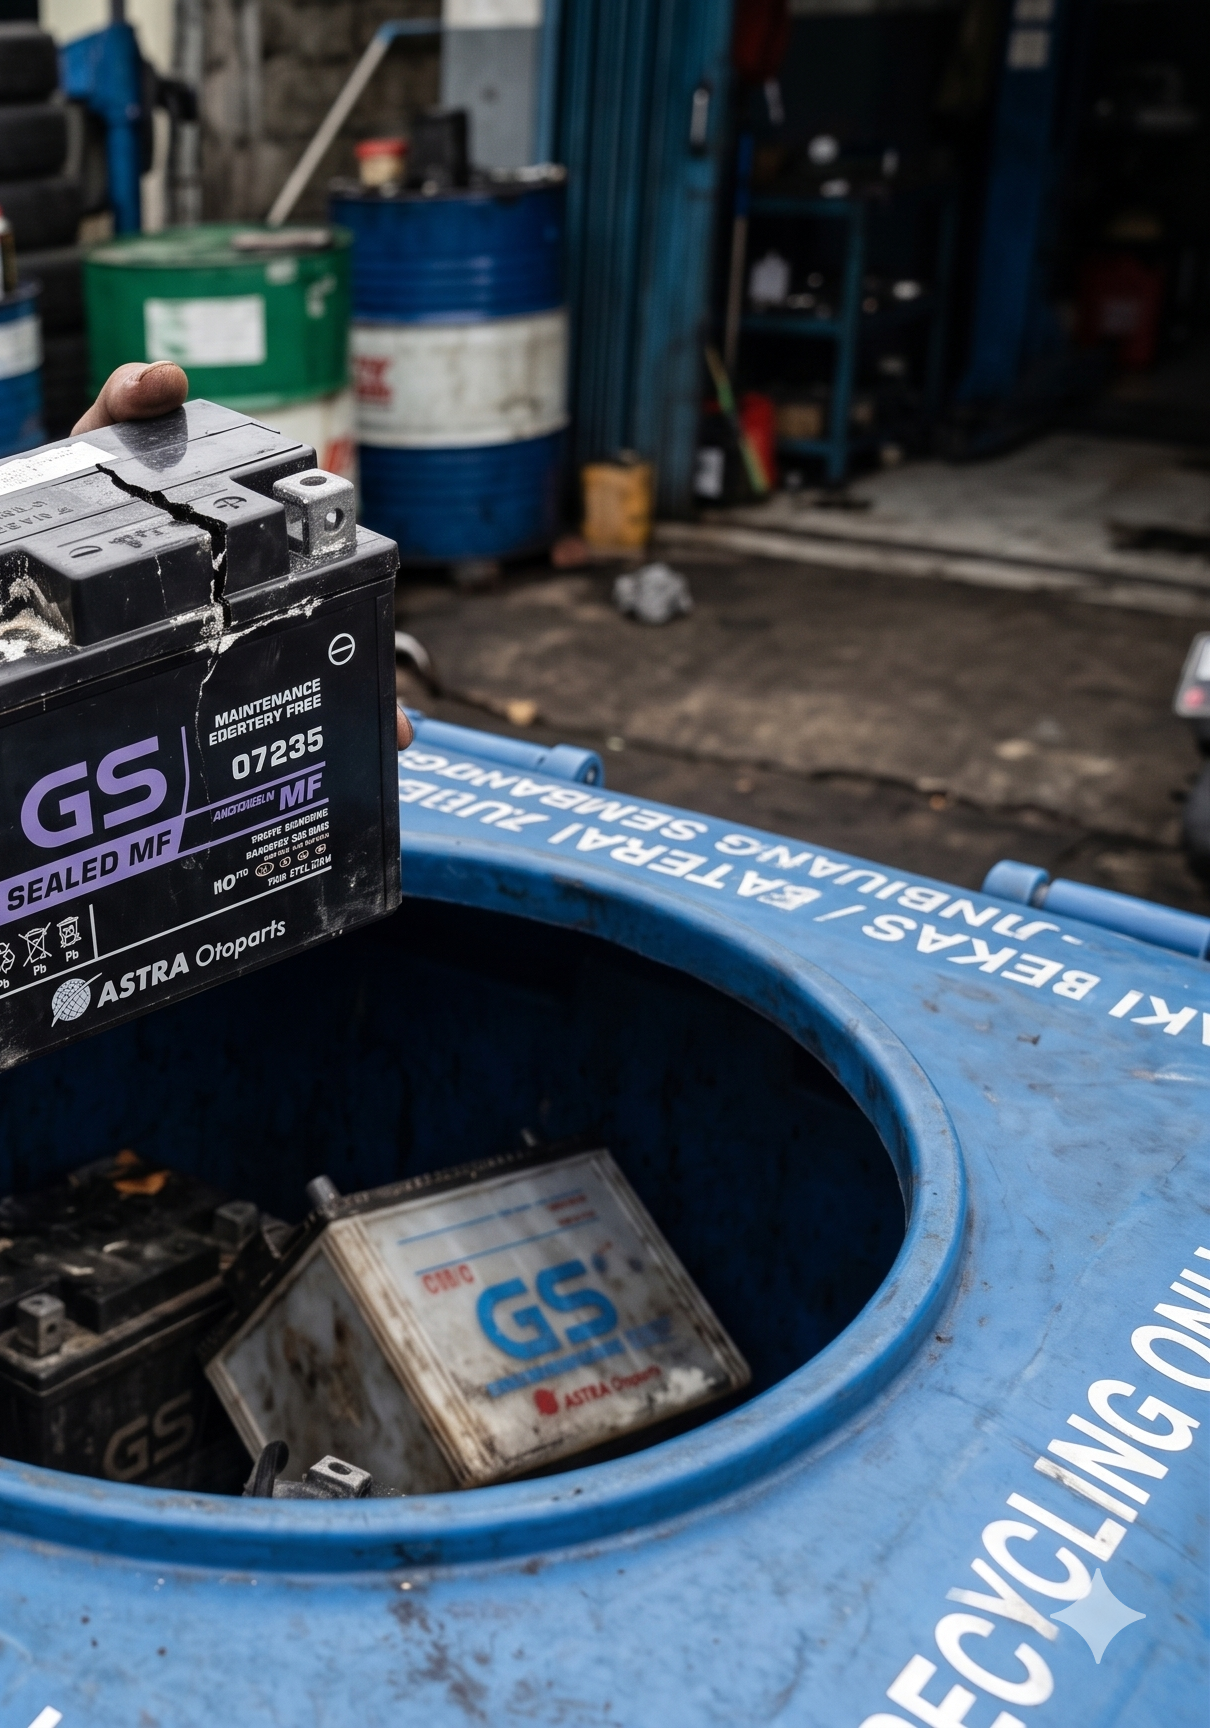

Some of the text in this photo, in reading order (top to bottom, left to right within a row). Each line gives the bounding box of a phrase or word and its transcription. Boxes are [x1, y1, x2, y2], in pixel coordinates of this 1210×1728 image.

[214, 677, 321, 728] MAINTENANCE
[286, 694, 322, 718] FREE
[231, 725, 324, 780] 07235
[20, 735, 168, 848] GS
[279, 772, 323, 811] MF
[7, 829, 172, 911] SEALED MF
[33, 963, 47, 976] Pb
[65, 950, 79, 962] Pb
[97, 920, 286, 1008] ASTRA Otoparts
[861, 914, 1101, 1000] BEKAS
[1108, 989, 1210, 1048] KI
[476, 1258, 618, 1361] GS
[103, 1390, 194, 1480] GS
[858, 1379, 1200, 1728] ECYCLING
